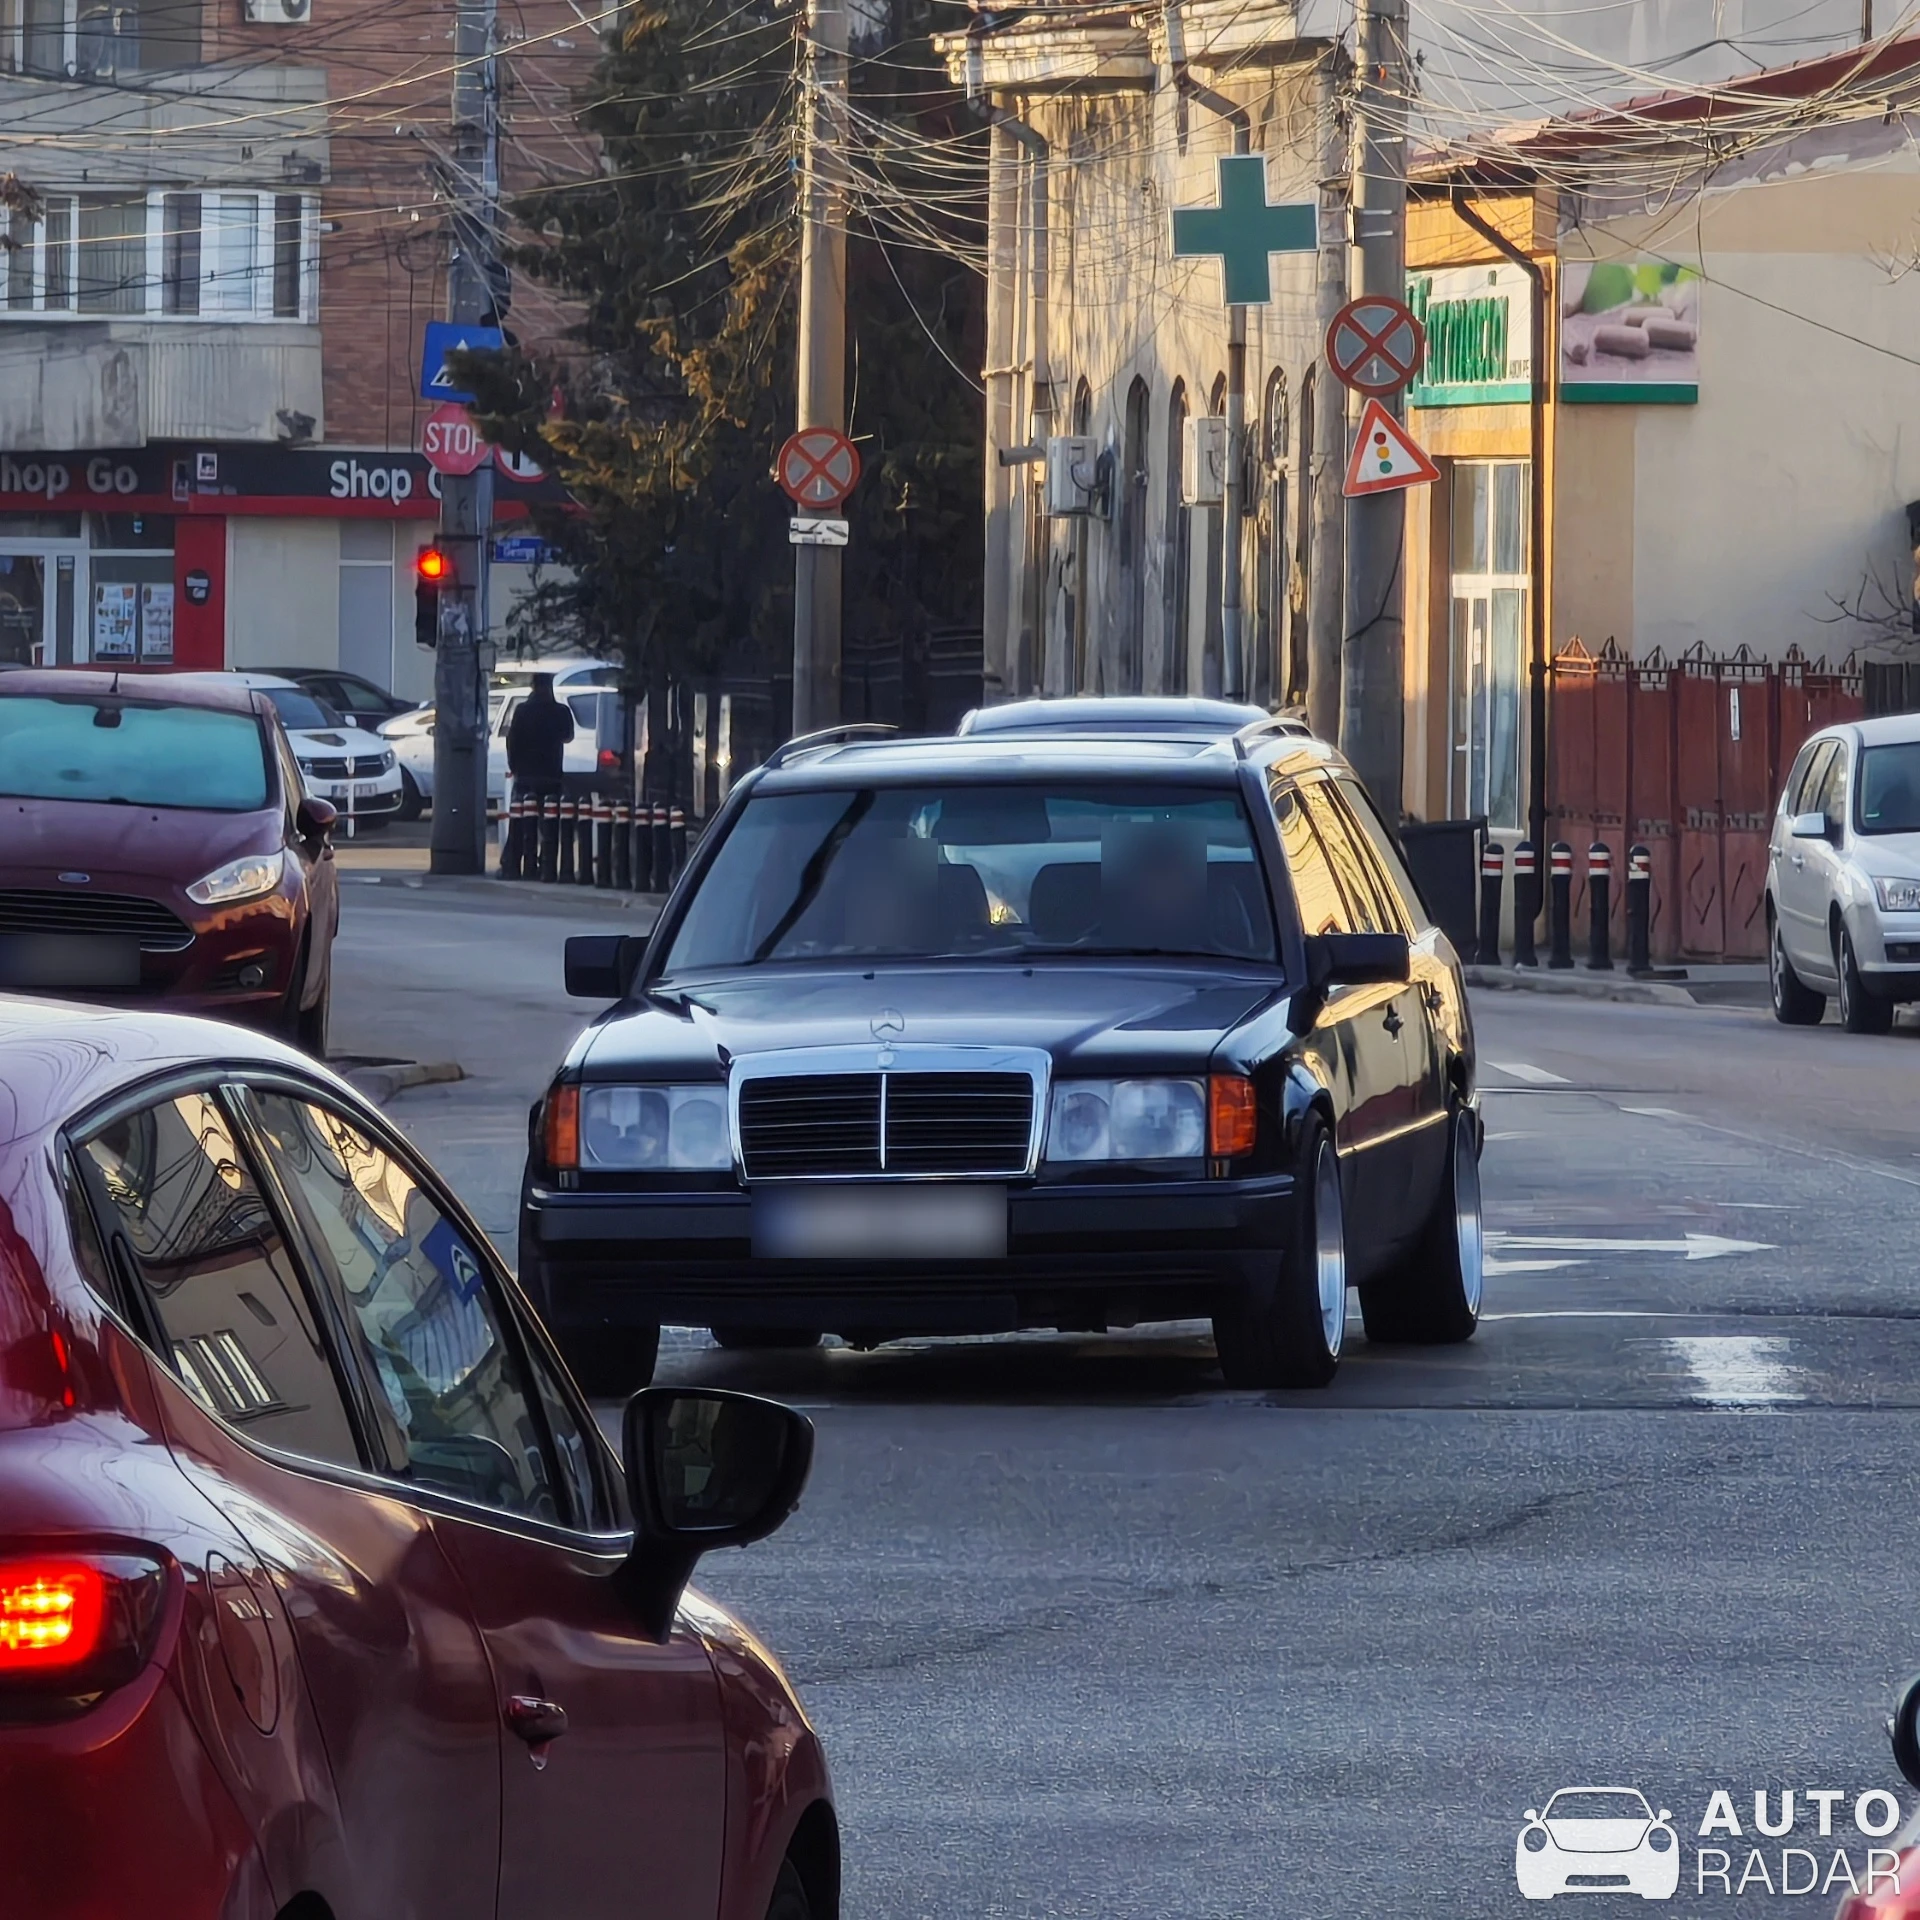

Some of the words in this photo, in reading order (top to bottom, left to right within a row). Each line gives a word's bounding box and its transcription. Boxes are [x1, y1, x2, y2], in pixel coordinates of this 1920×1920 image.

[1371, 360, 1378, 379] 1
[87, 457, 138, 493] Go
[330, 459, 412, 505] Shop
